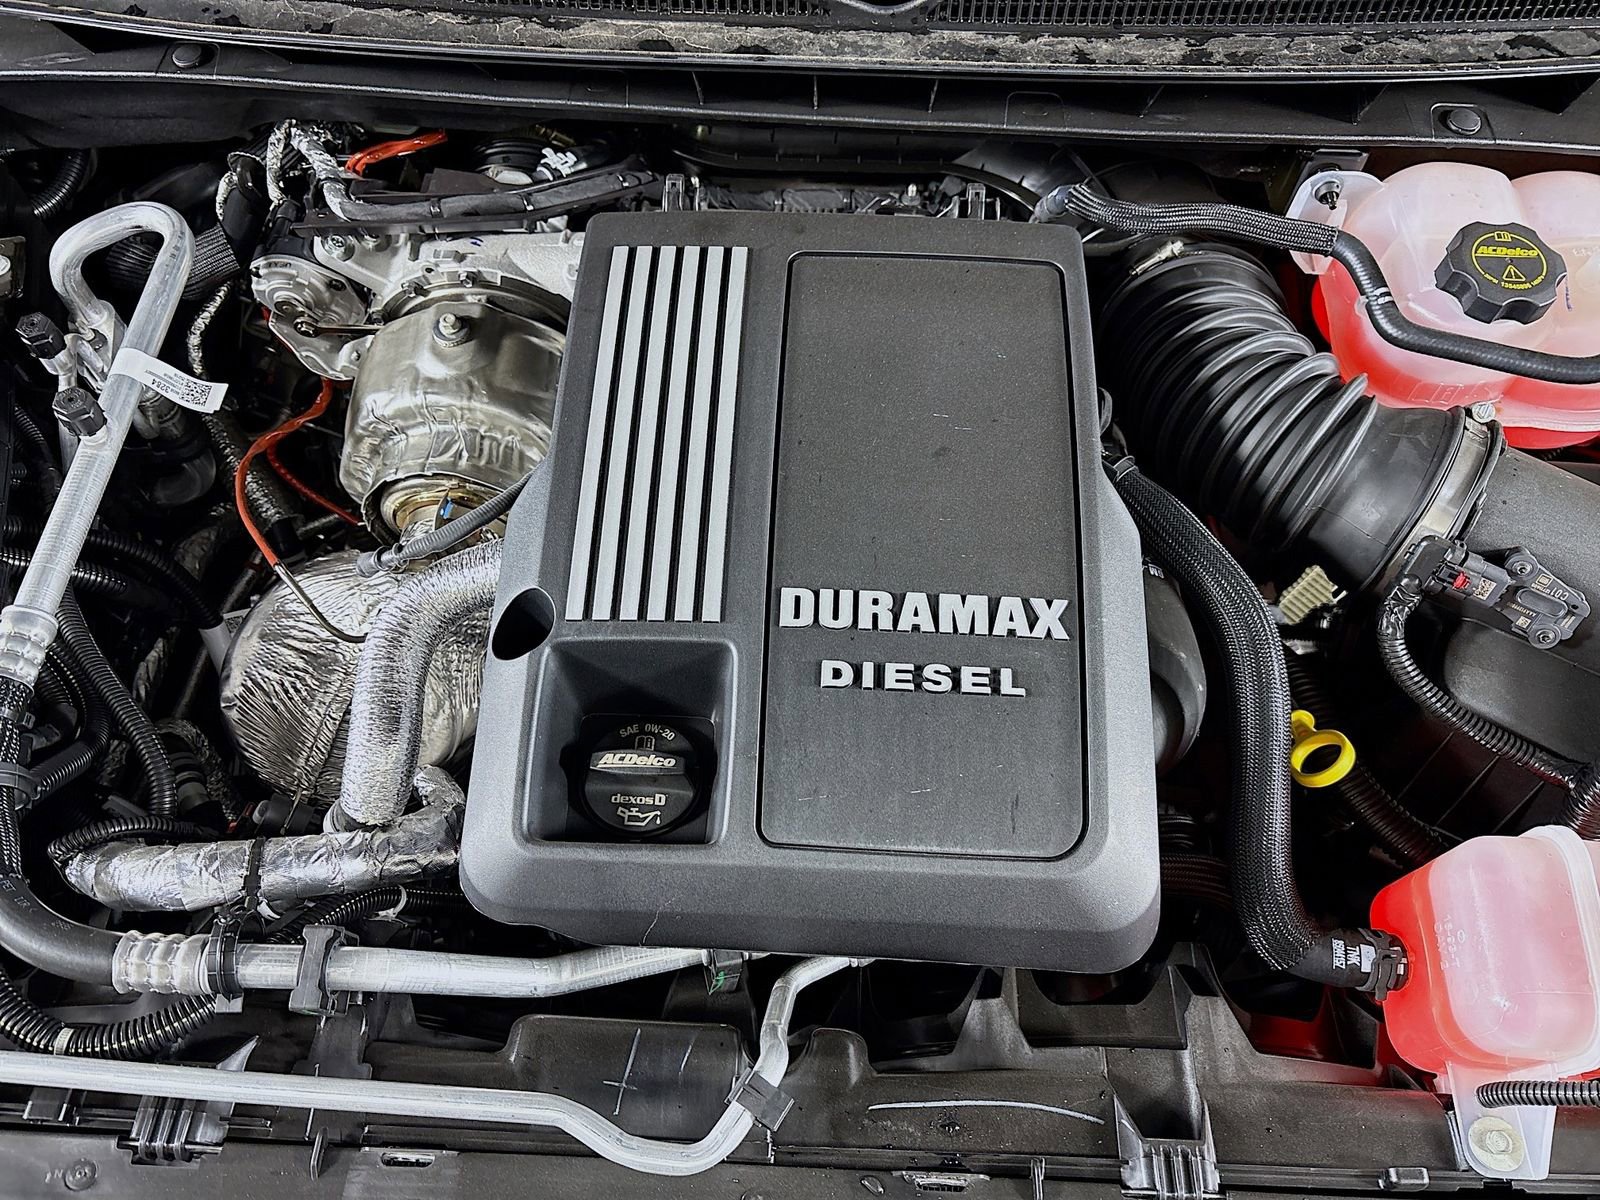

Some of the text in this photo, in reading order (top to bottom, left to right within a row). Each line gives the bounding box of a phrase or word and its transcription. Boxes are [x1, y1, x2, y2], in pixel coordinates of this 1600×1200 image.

[1476, 245, 1538, 257] ACDelco
[778, 587, 1070, 641] DURAMAX
[820, 660, 1026, 698] DIESEL
[619, 723, 676, 741] SAE 0W-20
[598, 753, 676, 768] ACDelco
